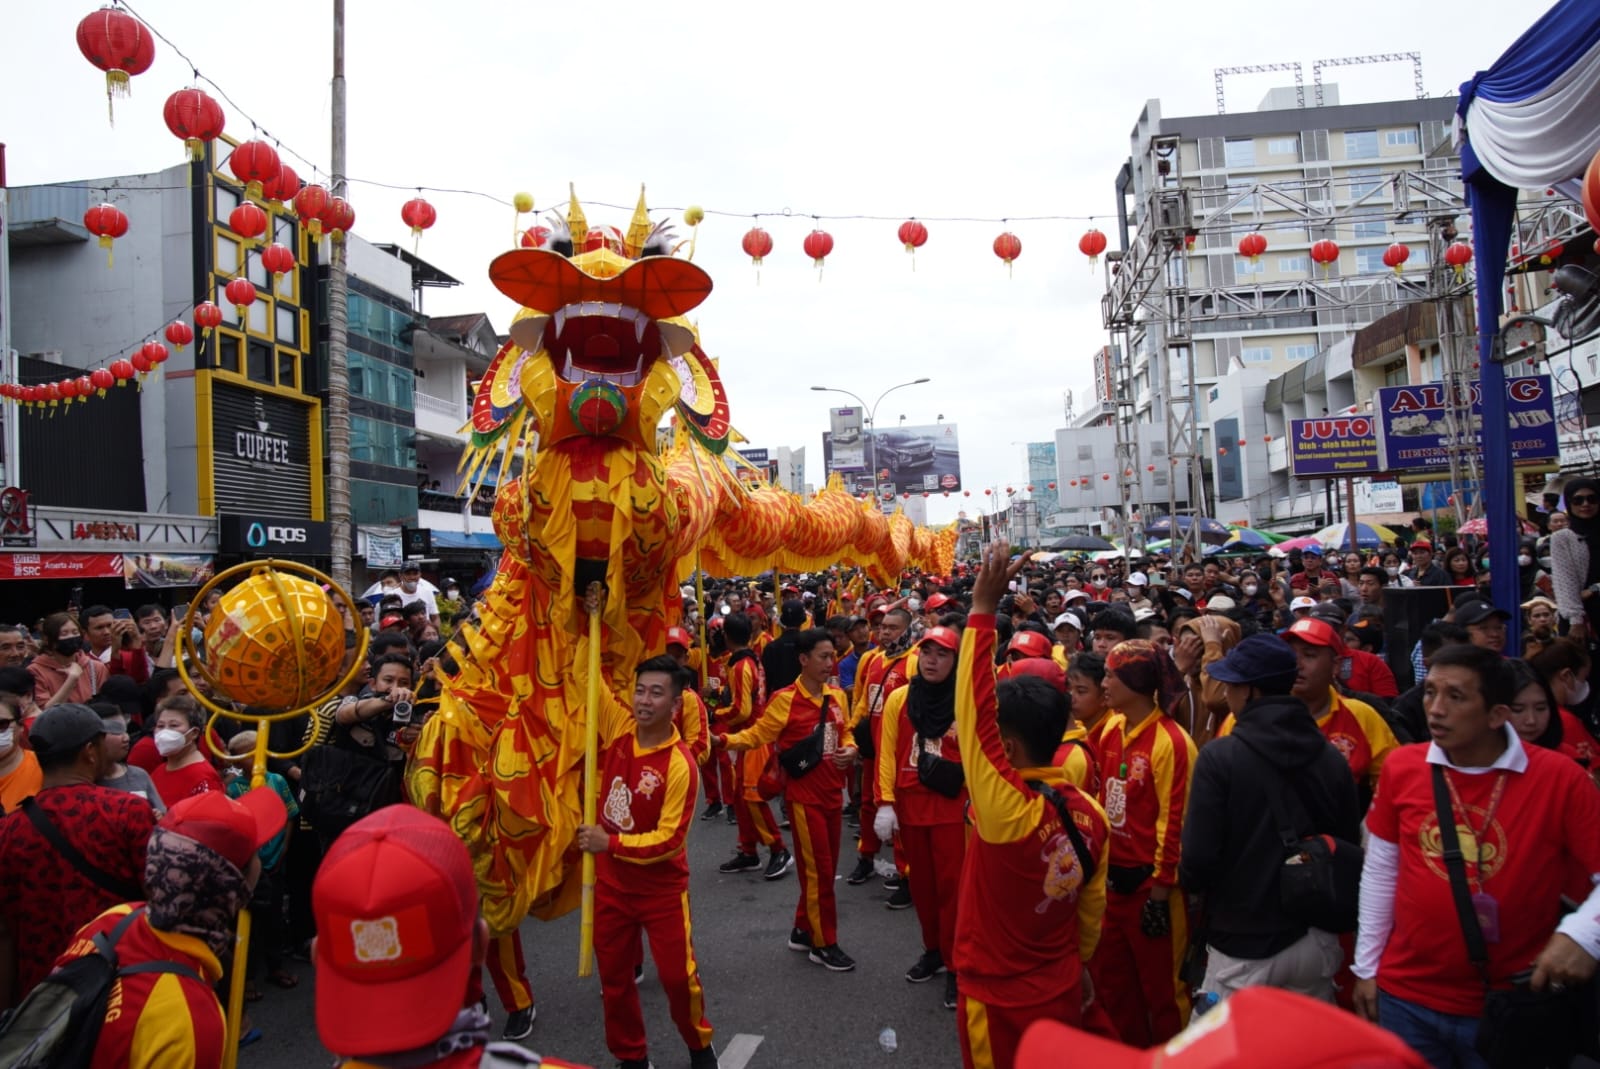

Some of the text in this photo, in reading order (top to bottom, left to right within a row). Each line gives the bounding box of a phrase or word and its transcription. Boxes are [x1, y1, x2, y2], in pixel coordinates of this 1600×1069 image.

[1389, 378, 1543, 413] ALOG
[1300, 417, 1376, 440] JUTO
[236, 431, 289, 464] CUPFEE
[1361, 438, 1377, 447] Pon
[1398, 447, 1457, 459] HEKEN
[1425, 455, 1456, 465] KHA
[75, 522, 137, 541] AMERTA
[267, 526, 307, 544] IQOS
[23, 566, 41, 576] SRC
